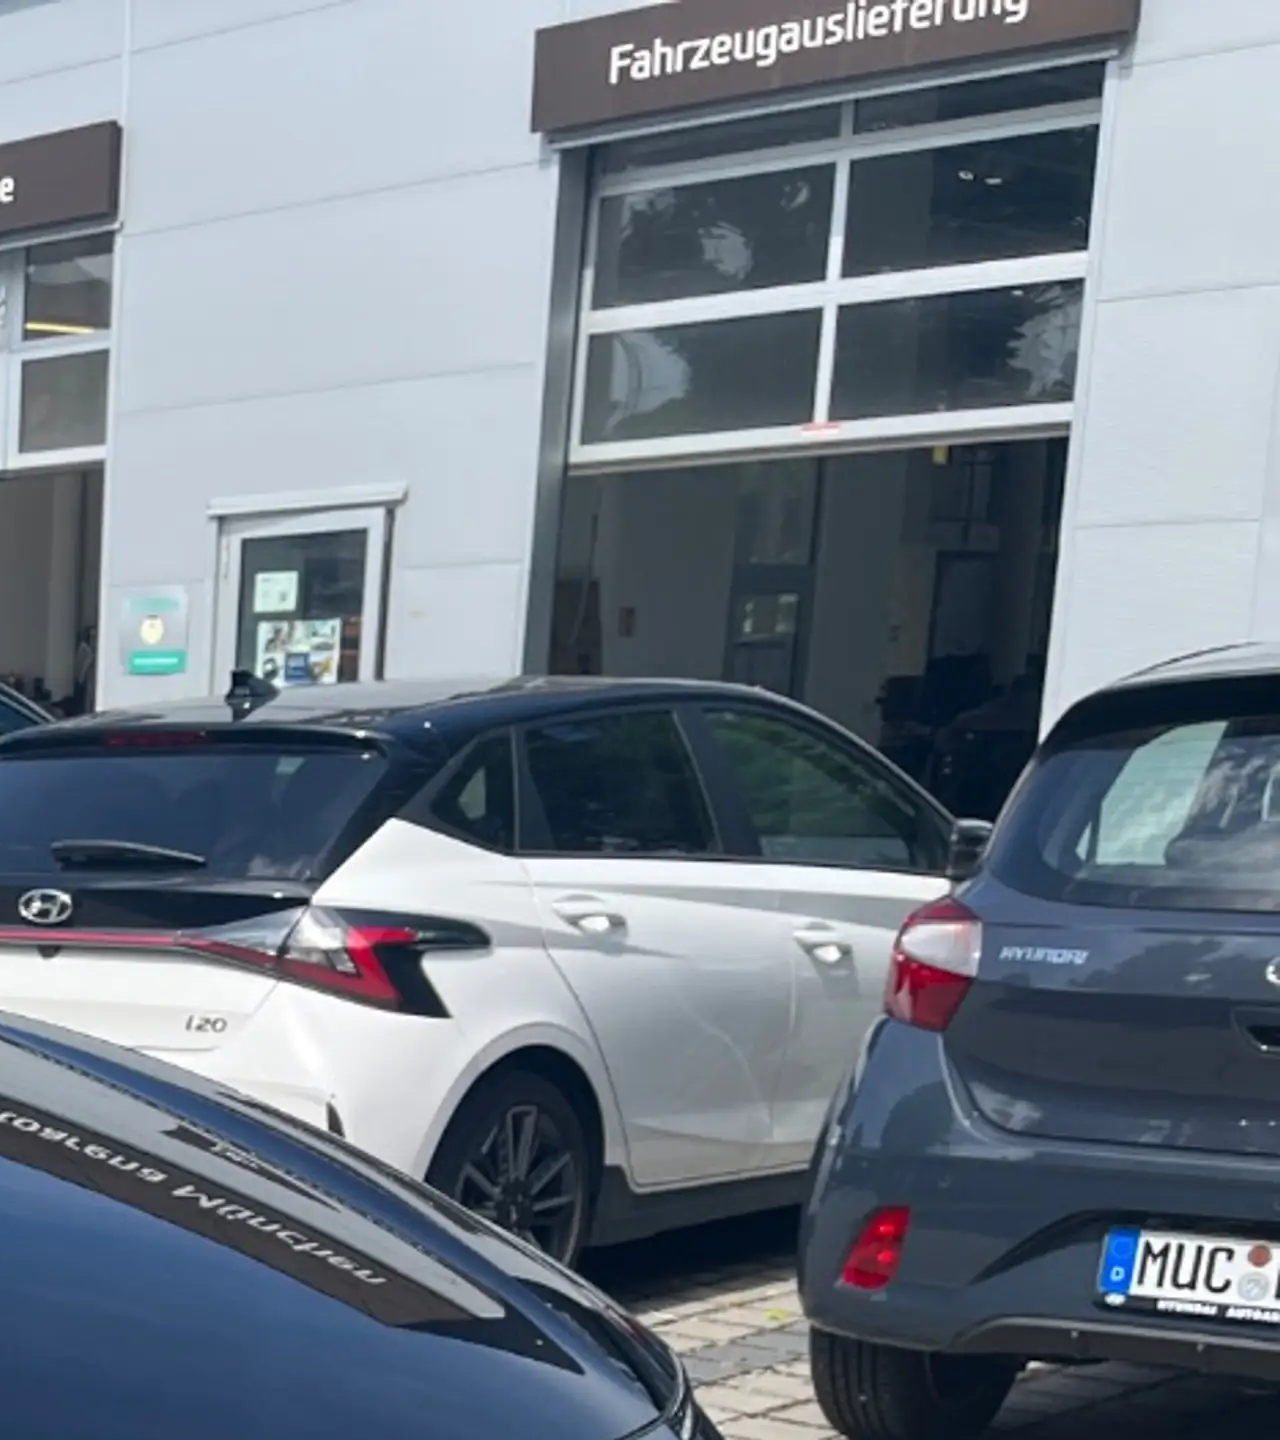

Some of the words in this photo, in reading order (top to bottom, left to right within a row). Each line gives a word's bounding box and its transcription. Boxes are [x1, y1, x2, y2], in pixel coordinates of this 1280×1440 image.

[999, 946, 1089, 965] HYUNDAI
[1109, 1266, 1126, 1282] D
[1136, 1239, 1235, 1294] MUC
